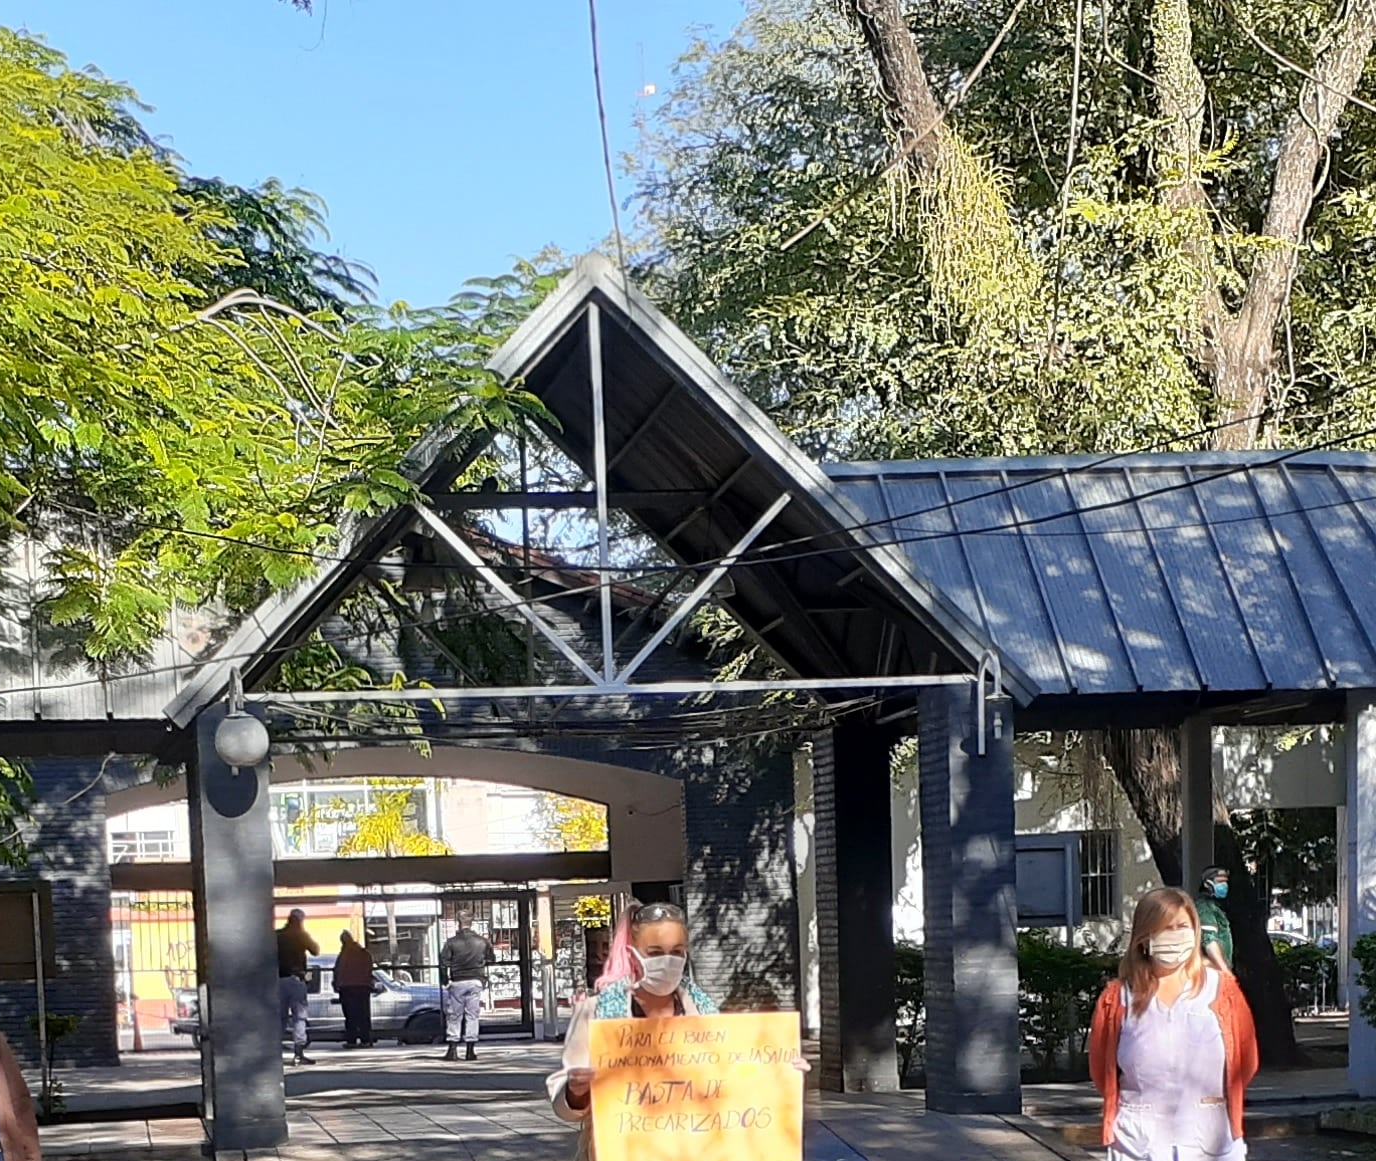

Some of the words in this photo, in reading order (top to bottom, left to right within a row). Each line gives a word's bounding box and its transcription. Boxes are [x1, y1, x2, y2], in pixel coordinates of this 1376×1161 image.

[618, 1024, 652, 1048] PARA
[682, 1030, 726, 1044] BUEN
[597, 1052, 721, 1069] FUNCIONAMIENTO
[625, 1080, 694, 1105] BASTA
[617, 1107, 773, 1134] PRECARIZADOS
